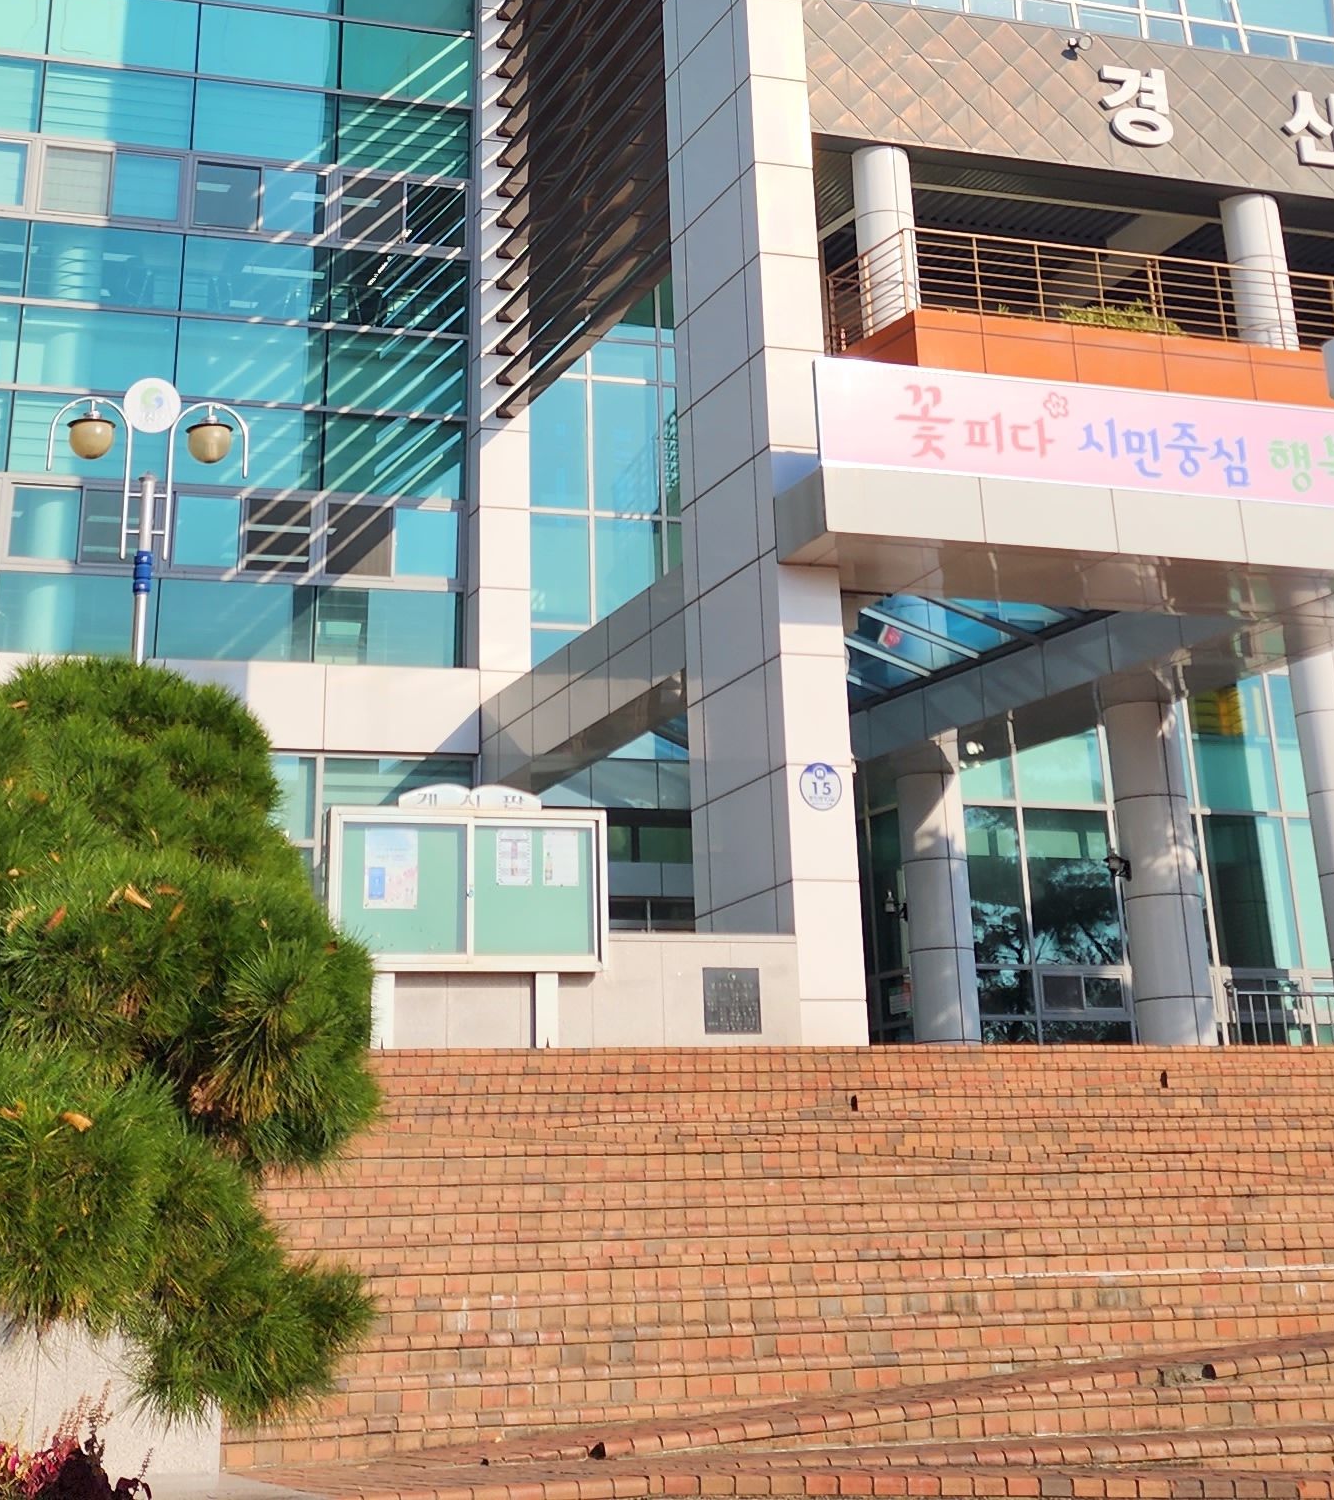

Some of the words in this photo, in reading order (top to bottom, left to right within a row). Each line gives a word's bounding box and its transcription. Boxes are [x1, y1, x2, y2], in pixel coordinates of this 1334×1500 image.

[895, 384, 1055, 460] 꽃피다
[1078, 418, 1250, 487] 시민중심
[812, 781, 832, 796] 15
